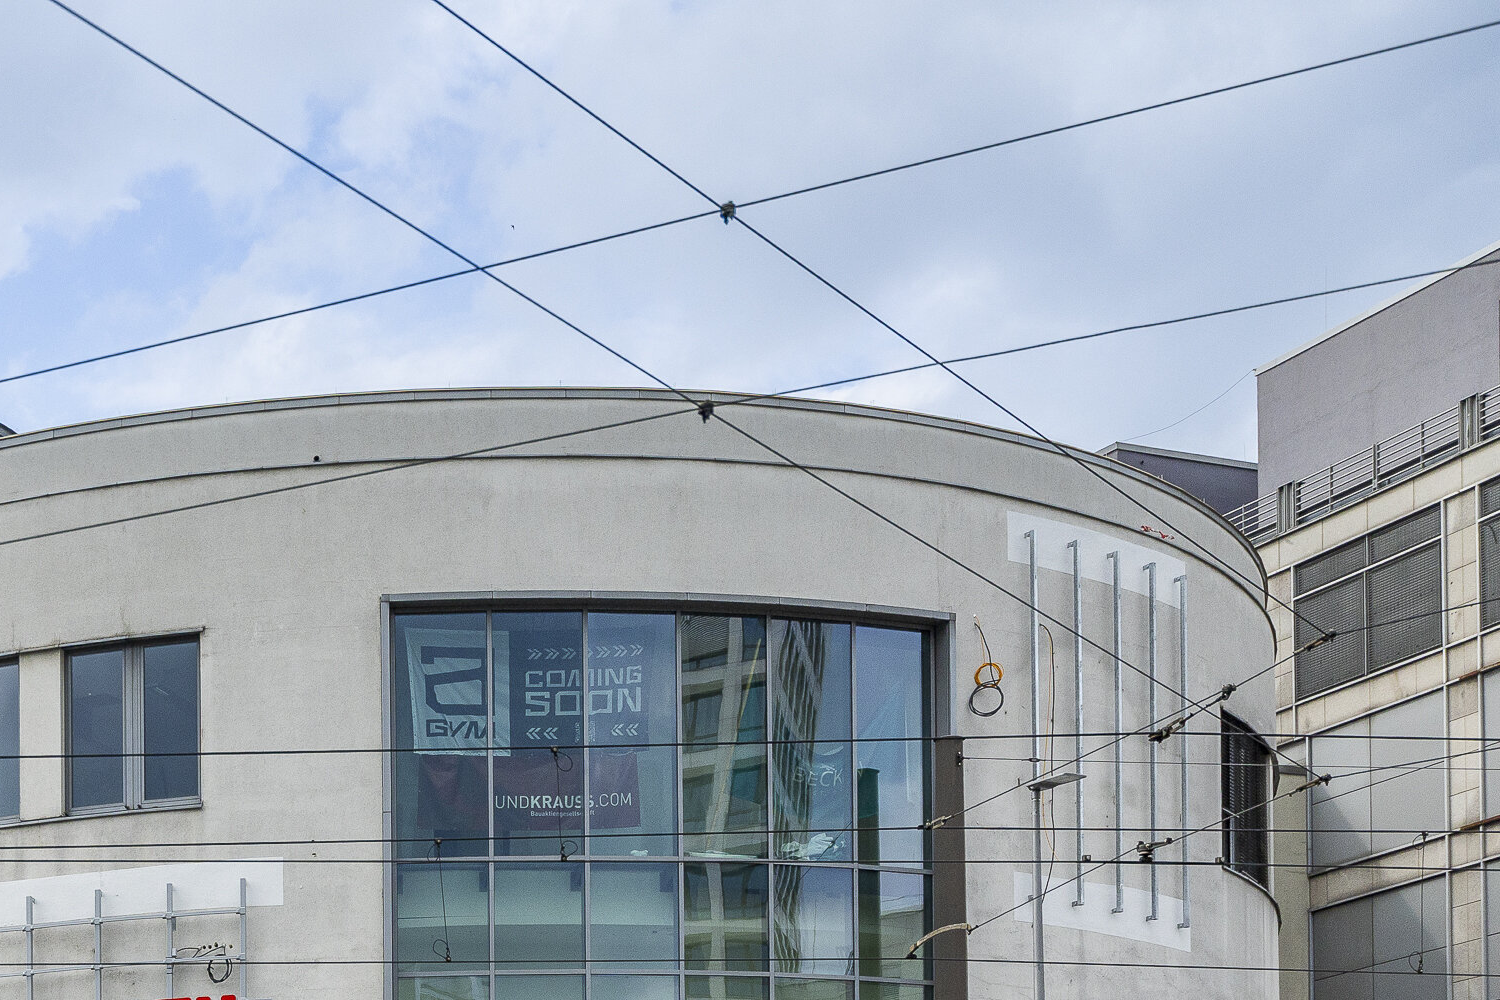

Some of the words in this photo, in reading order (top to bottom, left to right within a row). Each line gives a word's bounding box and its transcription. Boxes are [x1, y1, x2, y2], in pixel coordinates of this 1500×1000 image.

[525, 665, 642, 688] COMING
[525, 687, 642, 717] SOON
[426, 718, 497, 740] GYM
